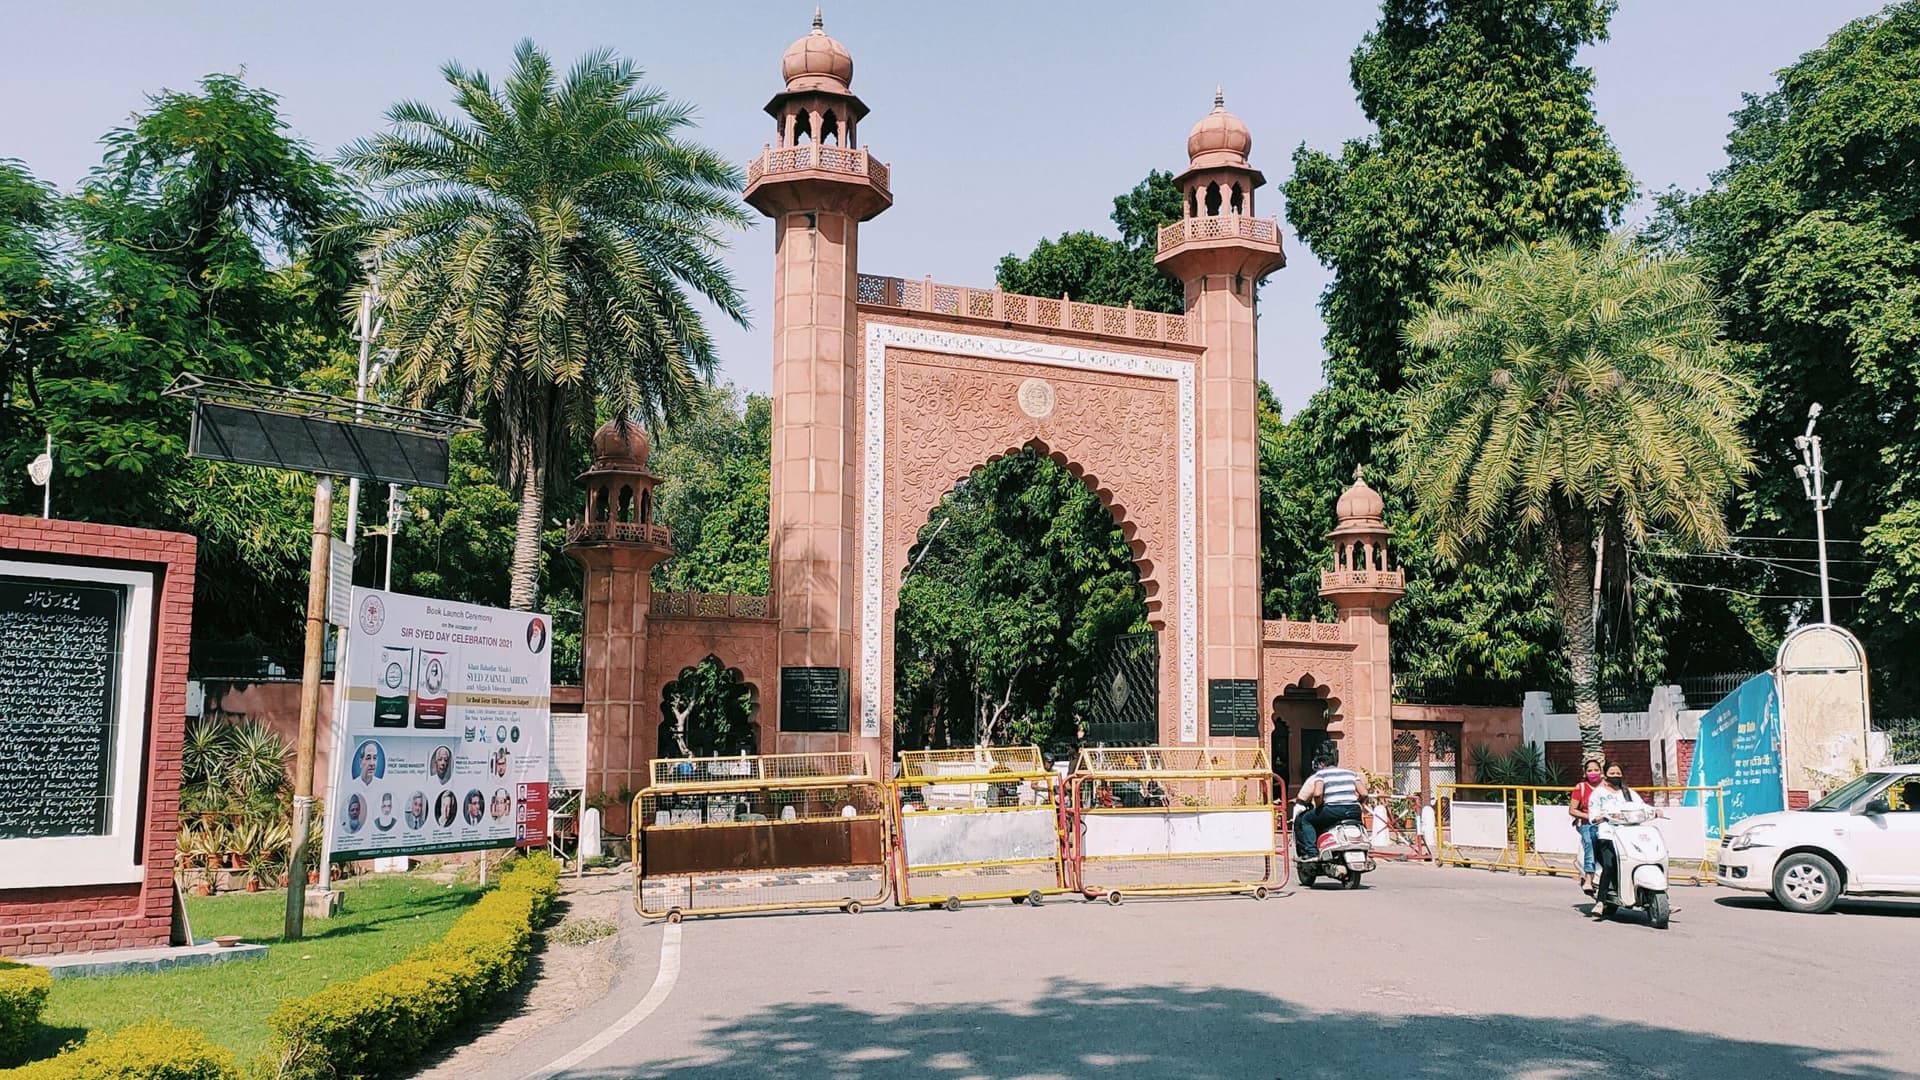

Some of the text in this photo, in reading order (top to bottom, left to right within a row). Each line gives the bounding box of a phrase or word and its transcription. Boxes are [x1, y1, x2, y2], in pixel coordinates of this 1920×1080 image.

[23, 591, 45, 606] ترانہ
[426, 605, 493, 624] Book Launch Ceremony
[401, 627, 513, 648] SIR SYED DAY CELEBRATION 2021
